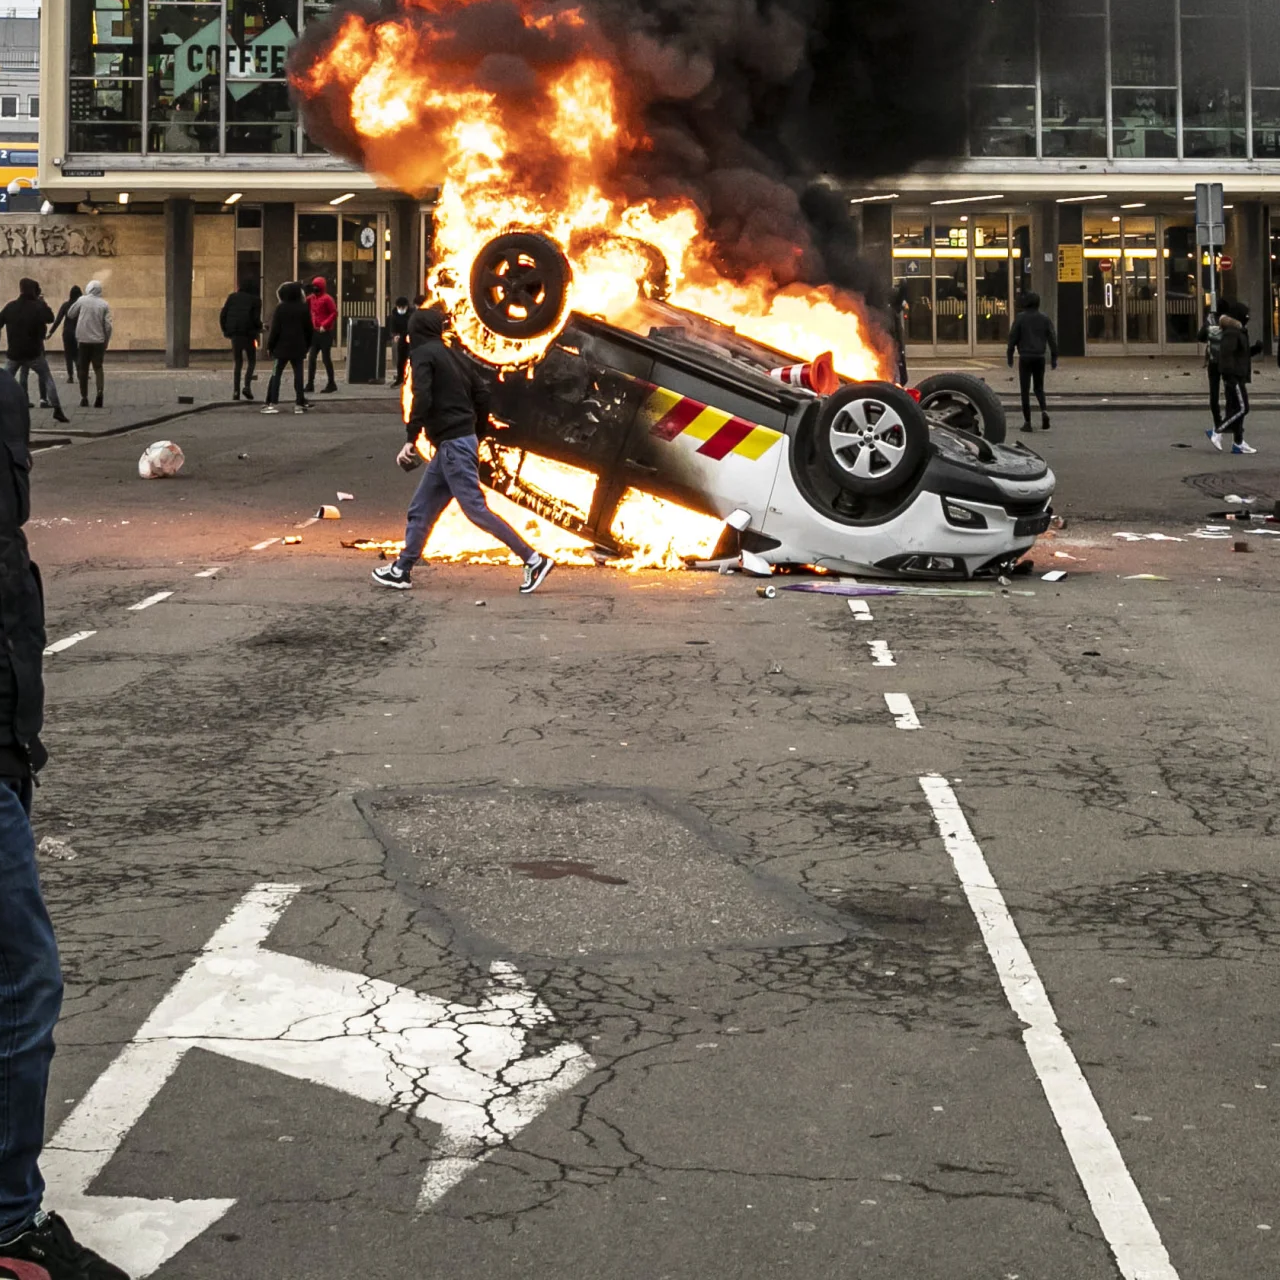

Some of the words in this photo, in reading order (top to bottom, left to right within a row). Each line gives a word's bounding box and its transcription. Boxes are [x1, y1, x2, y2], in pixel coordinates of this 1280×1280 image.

[187, 44, 285, 73] COFFEE
[0, 150, 8, 159] 2
[0, 193, 7, 202] 2
